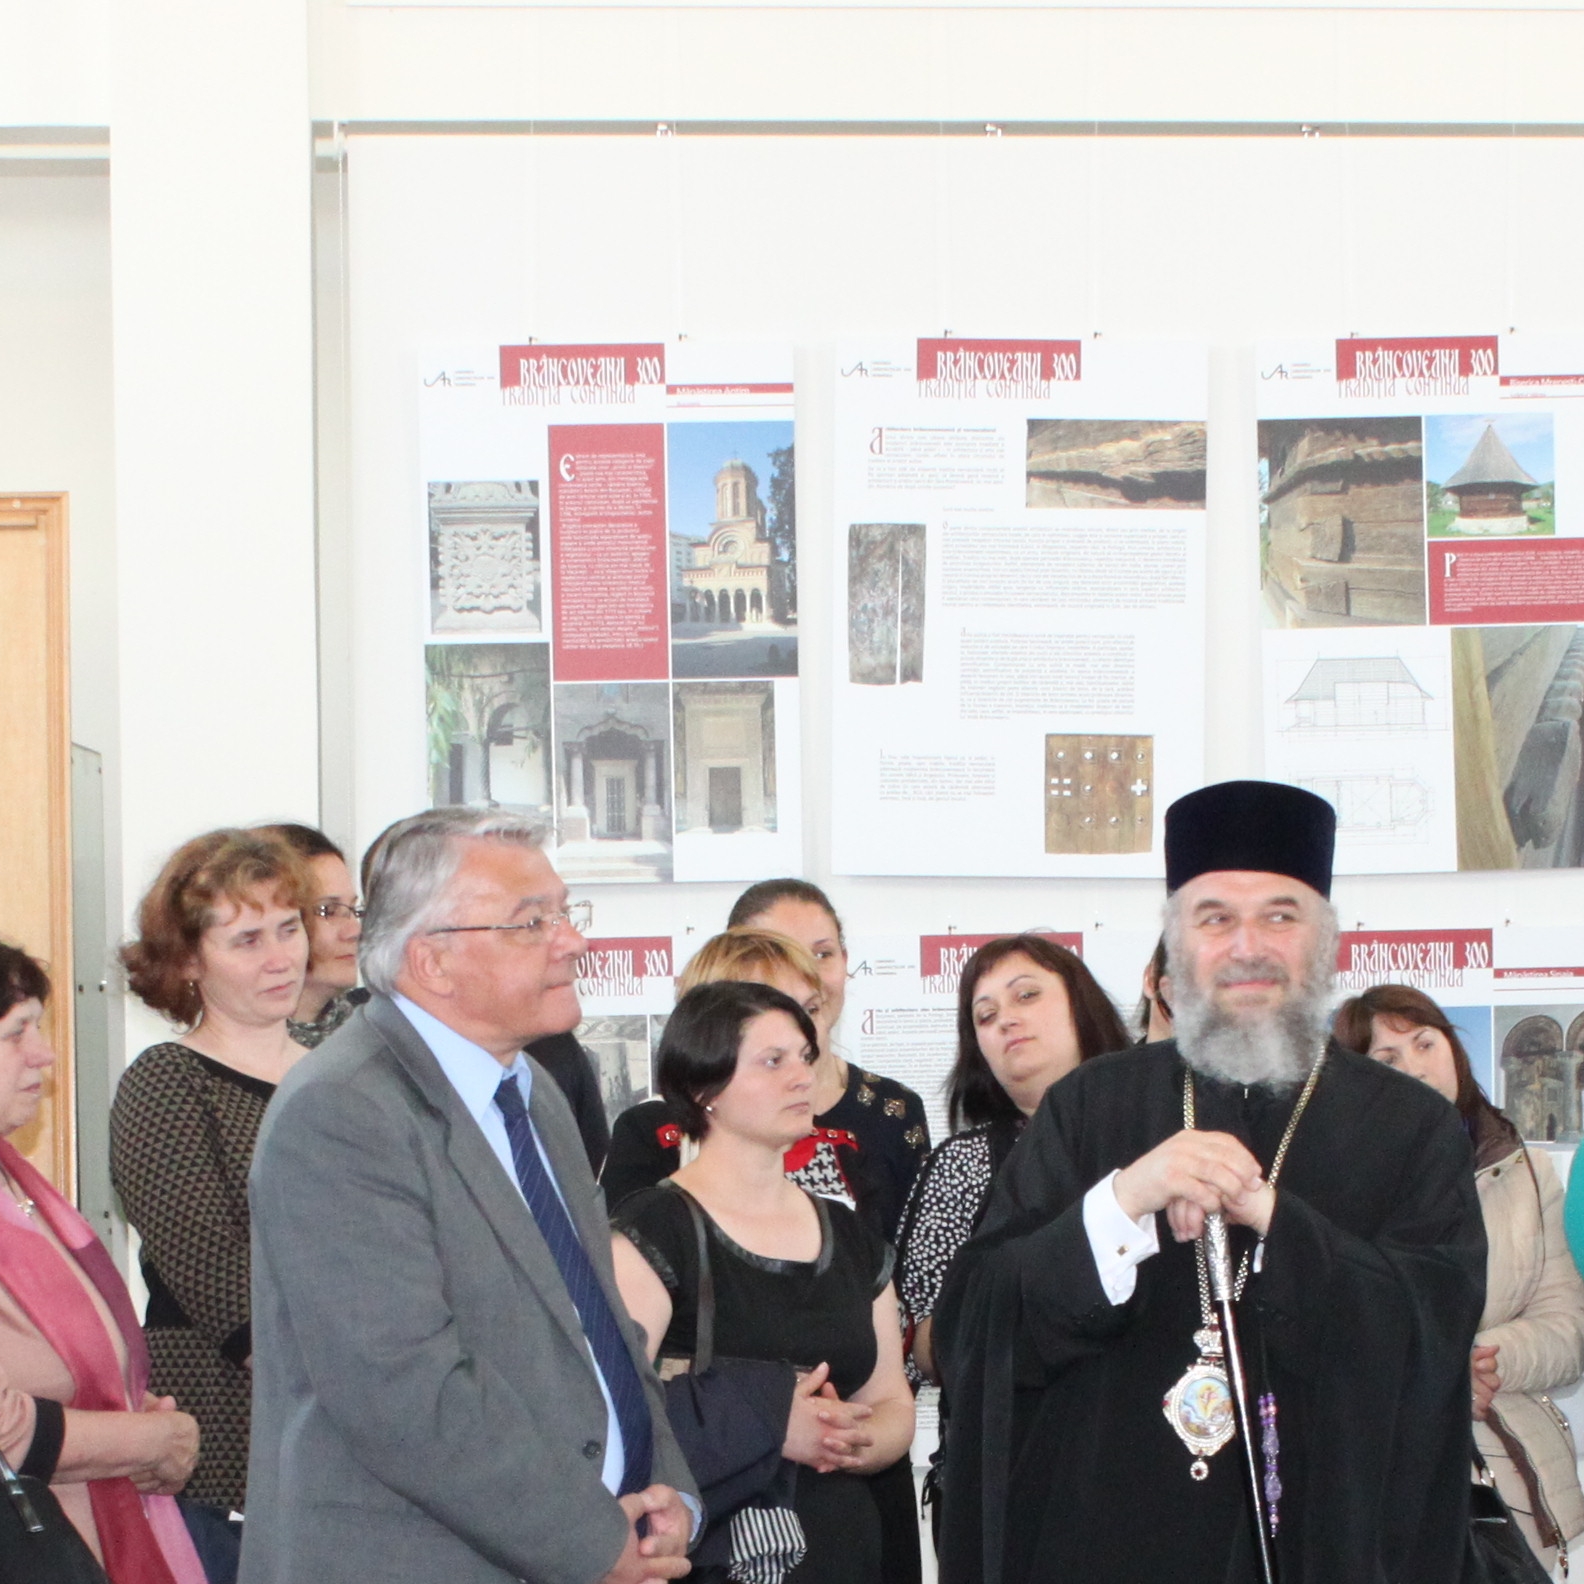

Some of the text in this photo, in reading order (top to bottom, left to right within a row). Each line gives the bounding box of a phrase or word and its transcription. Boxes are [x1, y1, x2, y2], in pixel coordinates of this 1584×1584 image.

[635, 356, 661, 385] 300
[1050, 353, 1078, 381] 300
[1469, 348, 1495, 376] 300
[576, 949, 669, 978] OVEANU 300
[1463, 941, 1489, 968] 300
